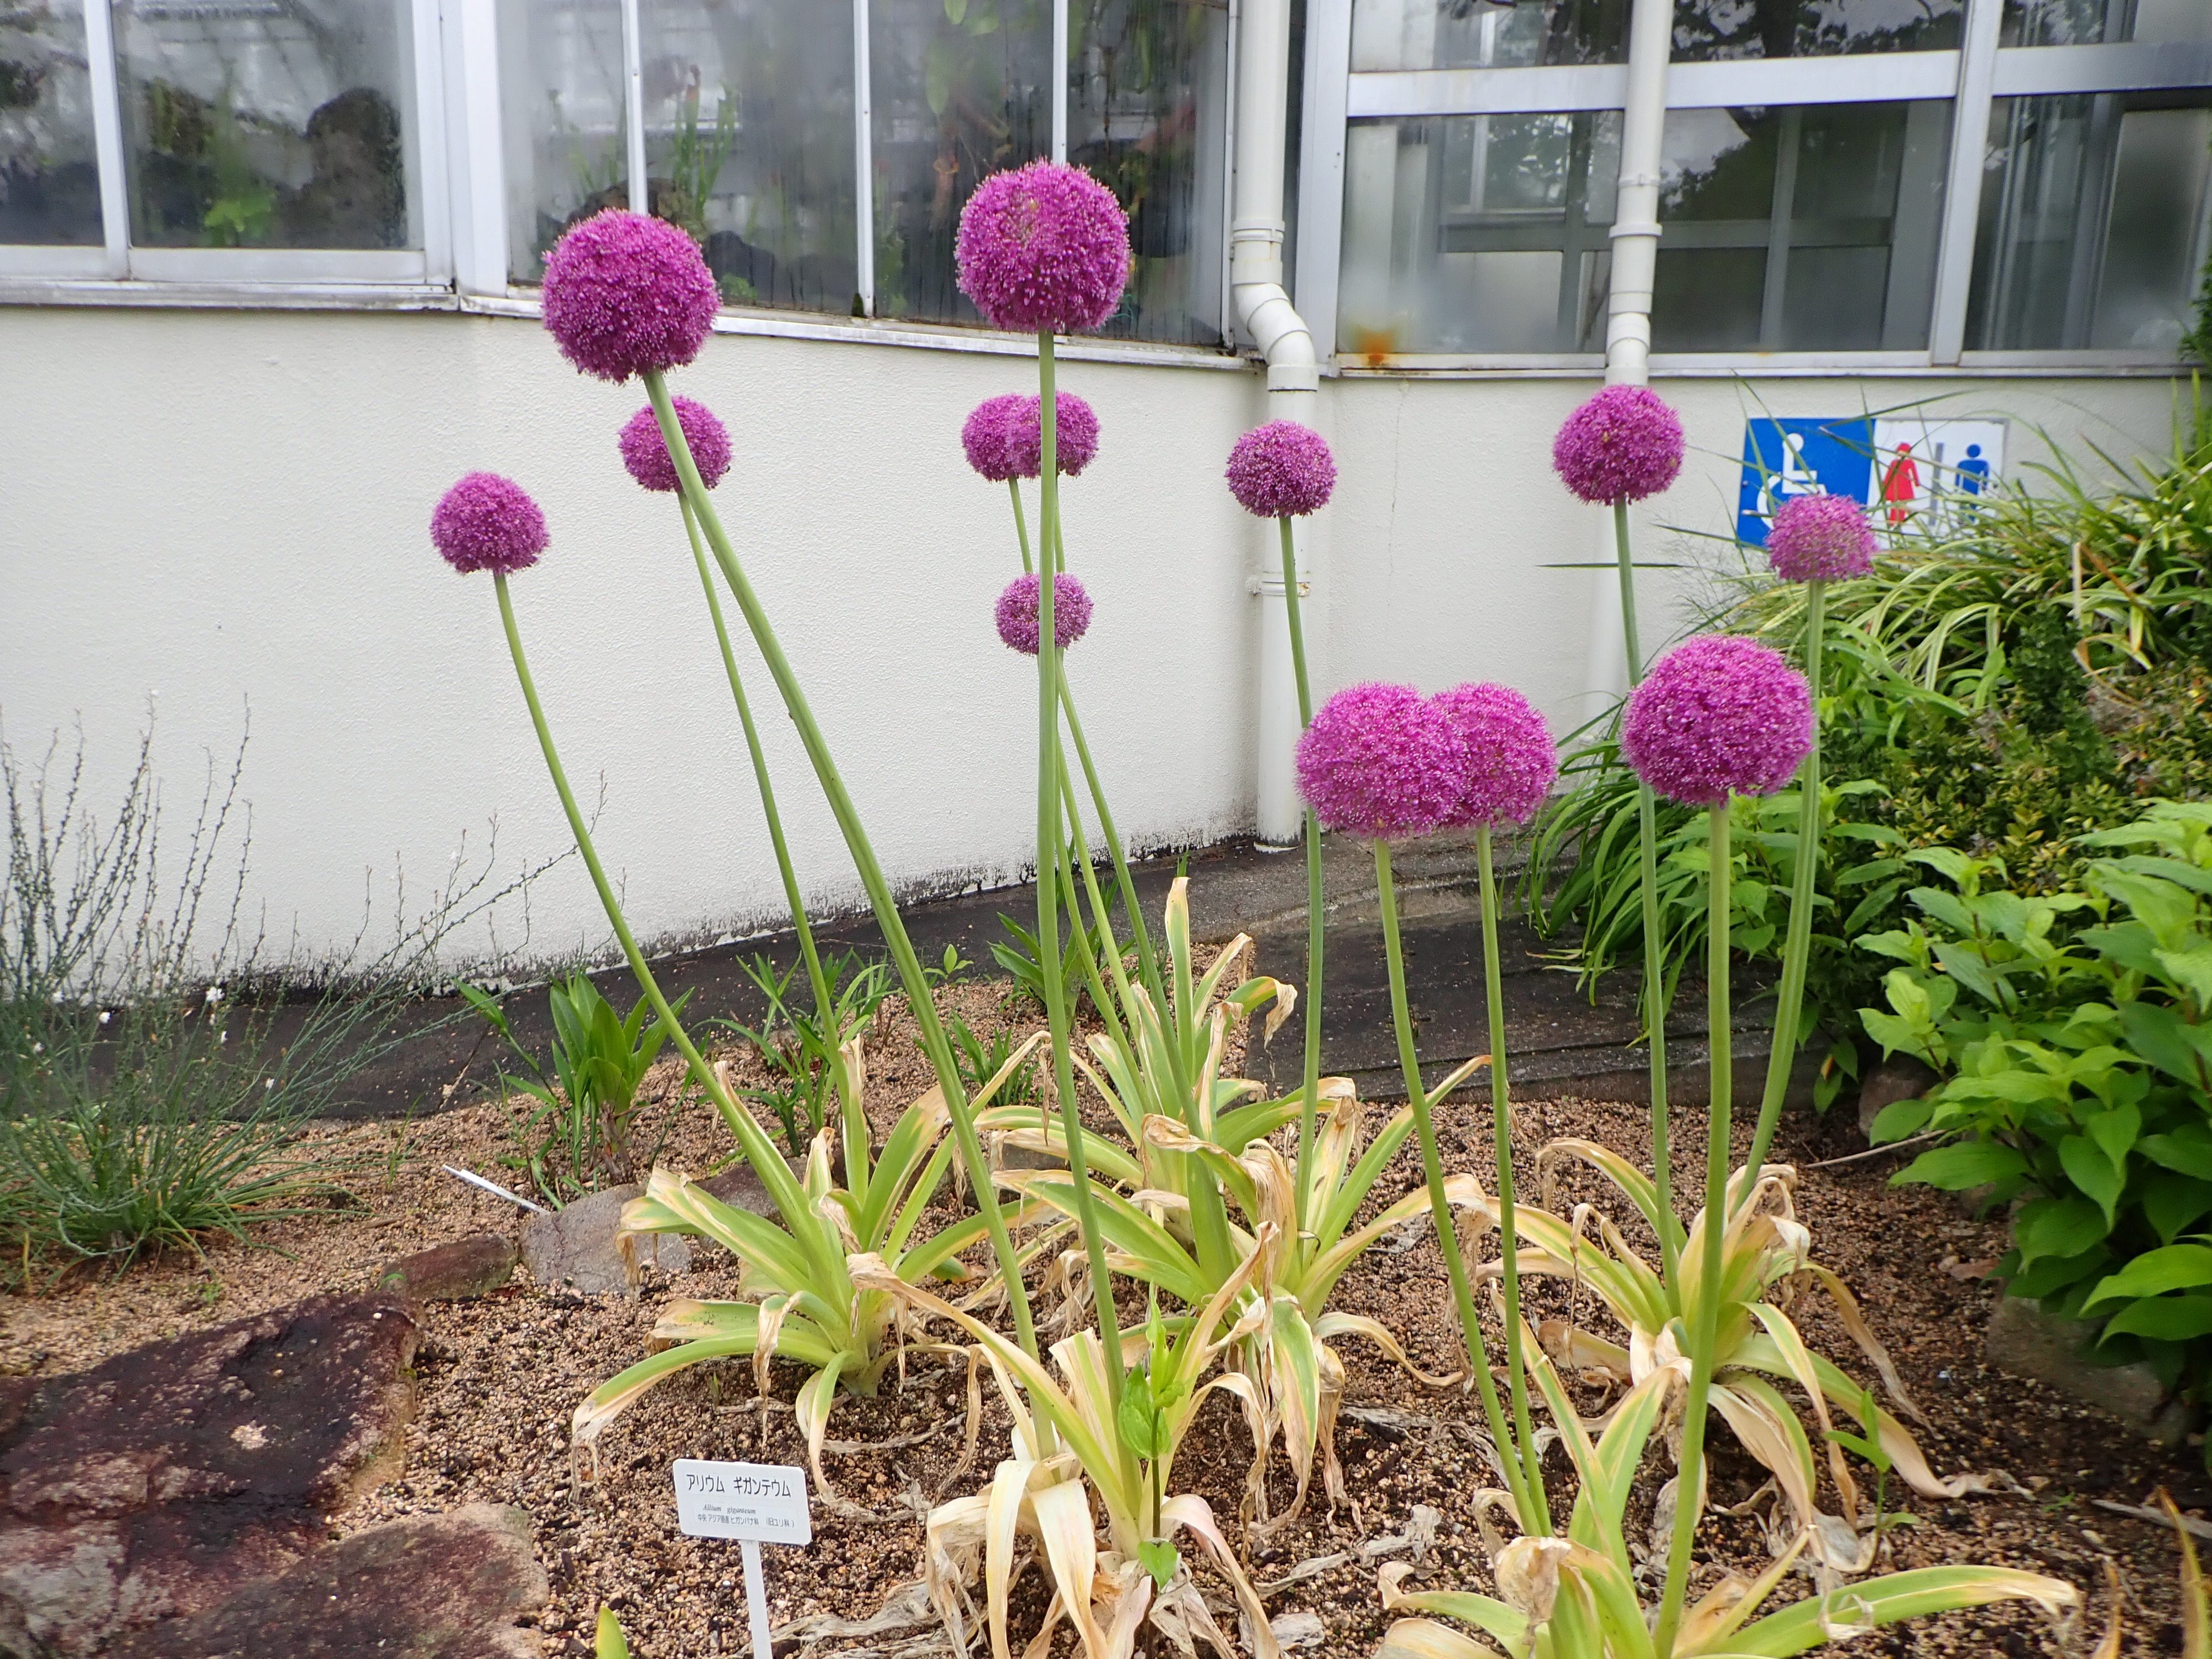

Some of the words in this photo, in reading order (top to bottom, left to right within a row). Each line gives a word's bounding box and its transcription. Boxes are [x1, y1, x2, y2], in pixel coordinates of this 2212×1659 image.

[686, 1474, 724, 1492] アリウム
[734, 1476, 791, 1497] ギガンテウム
